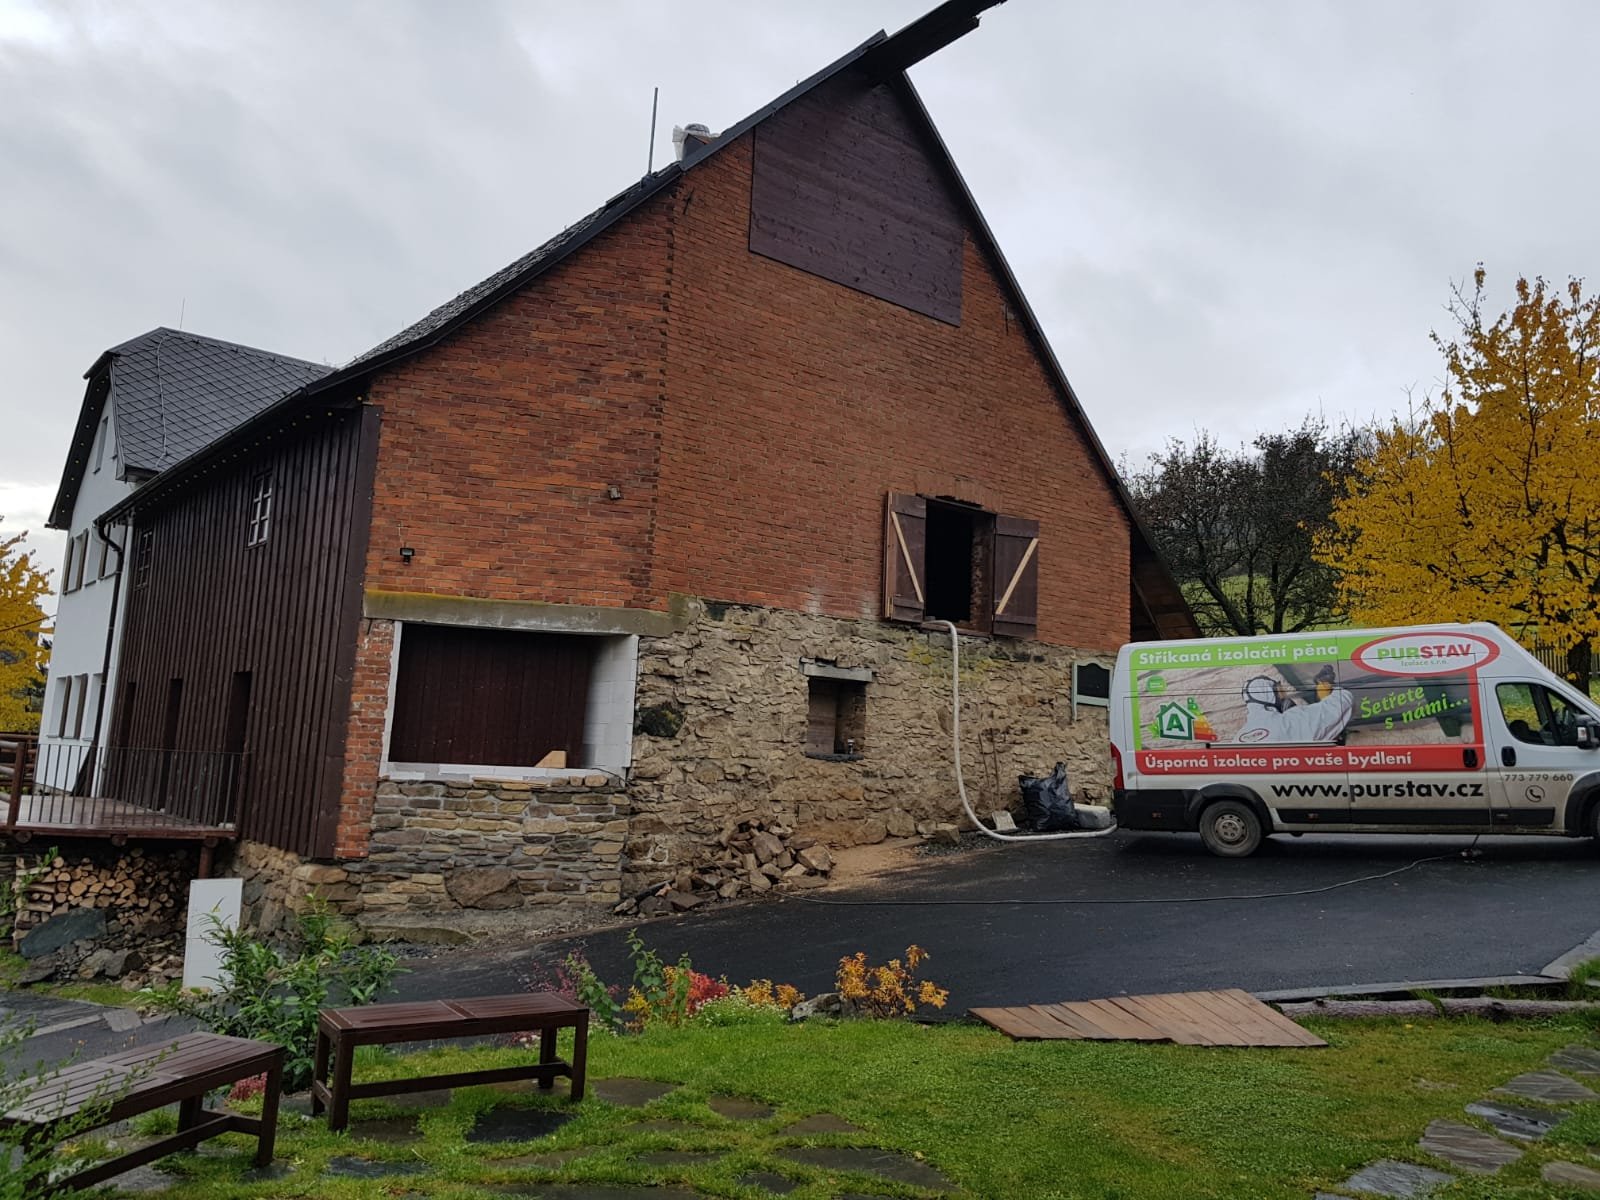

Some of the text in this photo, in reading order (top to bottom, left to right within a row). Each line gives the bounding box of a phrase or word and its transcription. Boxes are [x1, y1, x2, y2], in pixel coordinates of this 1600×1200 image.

[1140, 643, 1339, 665] Stříkaná izolační pěna
[1377, 644, 1471, 660] PURSTAV
[1360, 687, 1425, 718] Šetřete
[1166, 713, 1185, 732] A
[1385, 717, 1394, 730] s
[1145, 751, 1412, 770] Úsporná izolace pro vaše bydlení
[1504, 773, 1574, 782] 773 779 660
[1271, 781, 1484, 802] www.purstav.cz
